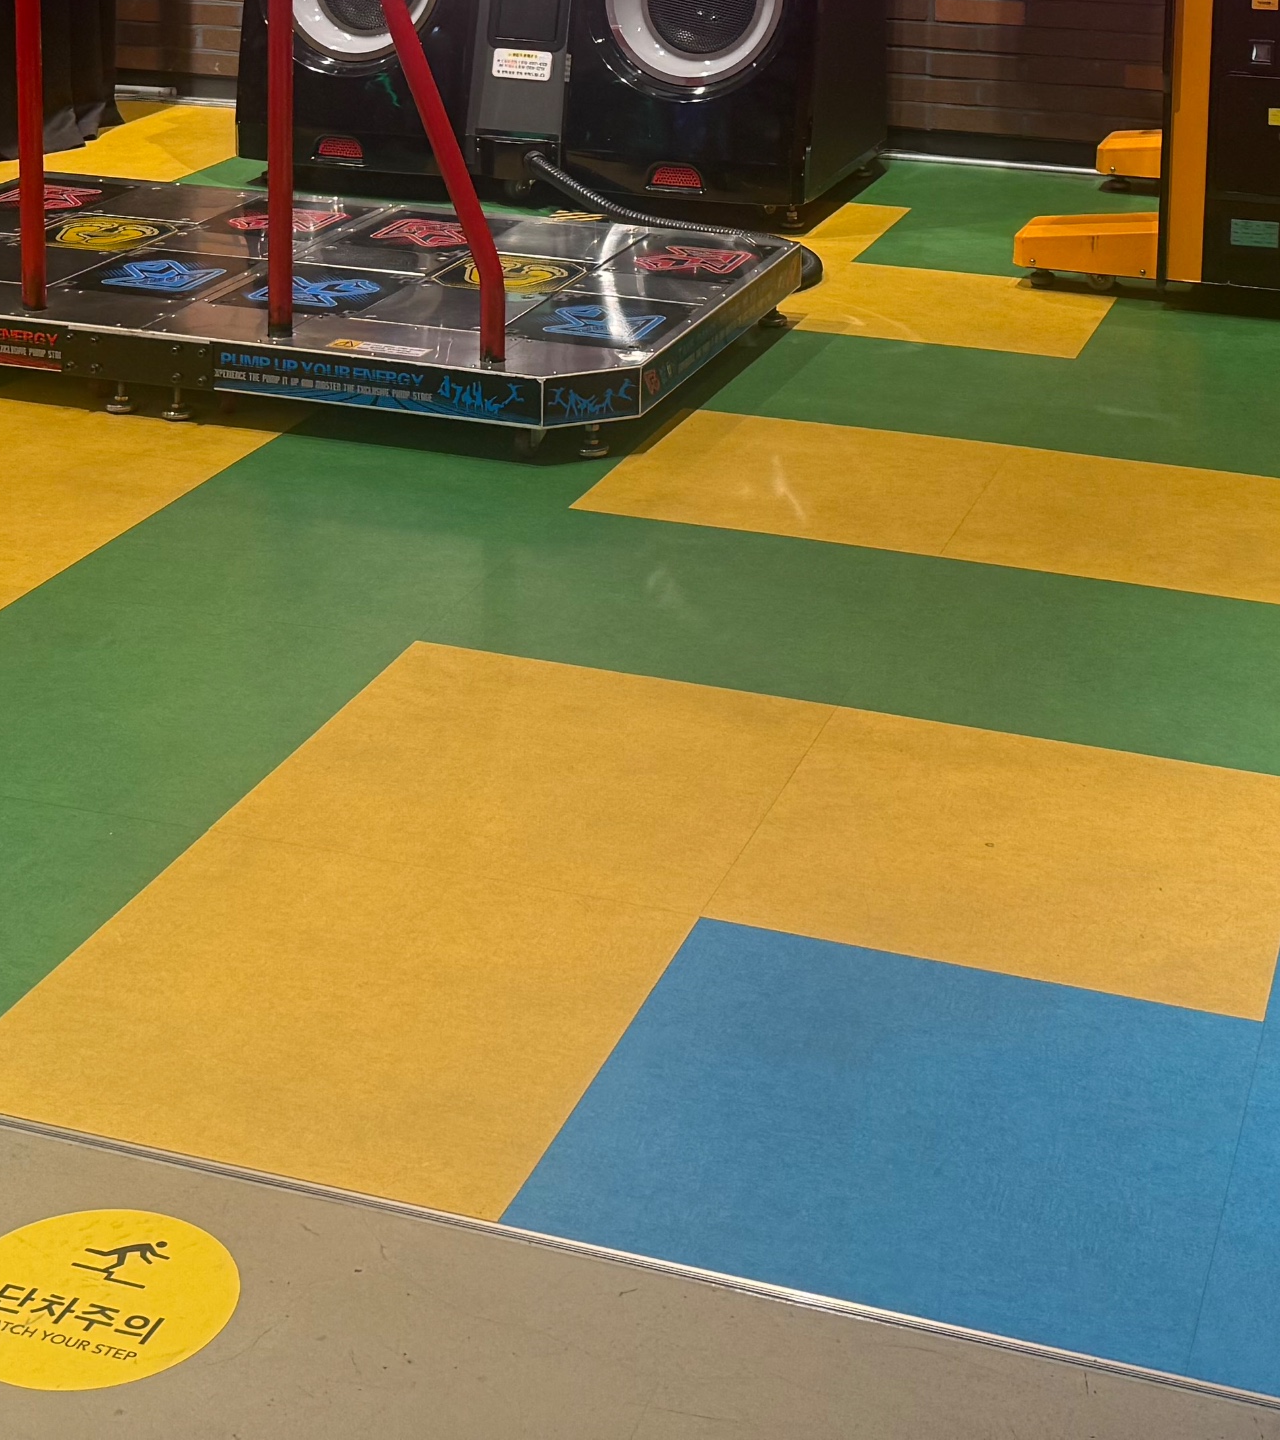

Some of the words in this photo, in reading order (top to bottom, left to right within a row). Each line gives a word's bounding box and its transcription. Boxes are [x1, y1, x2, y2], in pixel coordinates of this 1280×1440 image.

[220, 351, 271, 368] PUMP
[274, 358, 299, 372] UP
[301, 361, 350, 378] YOUR
[352, 367, 425, 387] ENERGY
[249, 372, 260, 382] THE
[40, 1330, 91, 1352] YOUR
[91, 1343, 138, 1361] STEP
